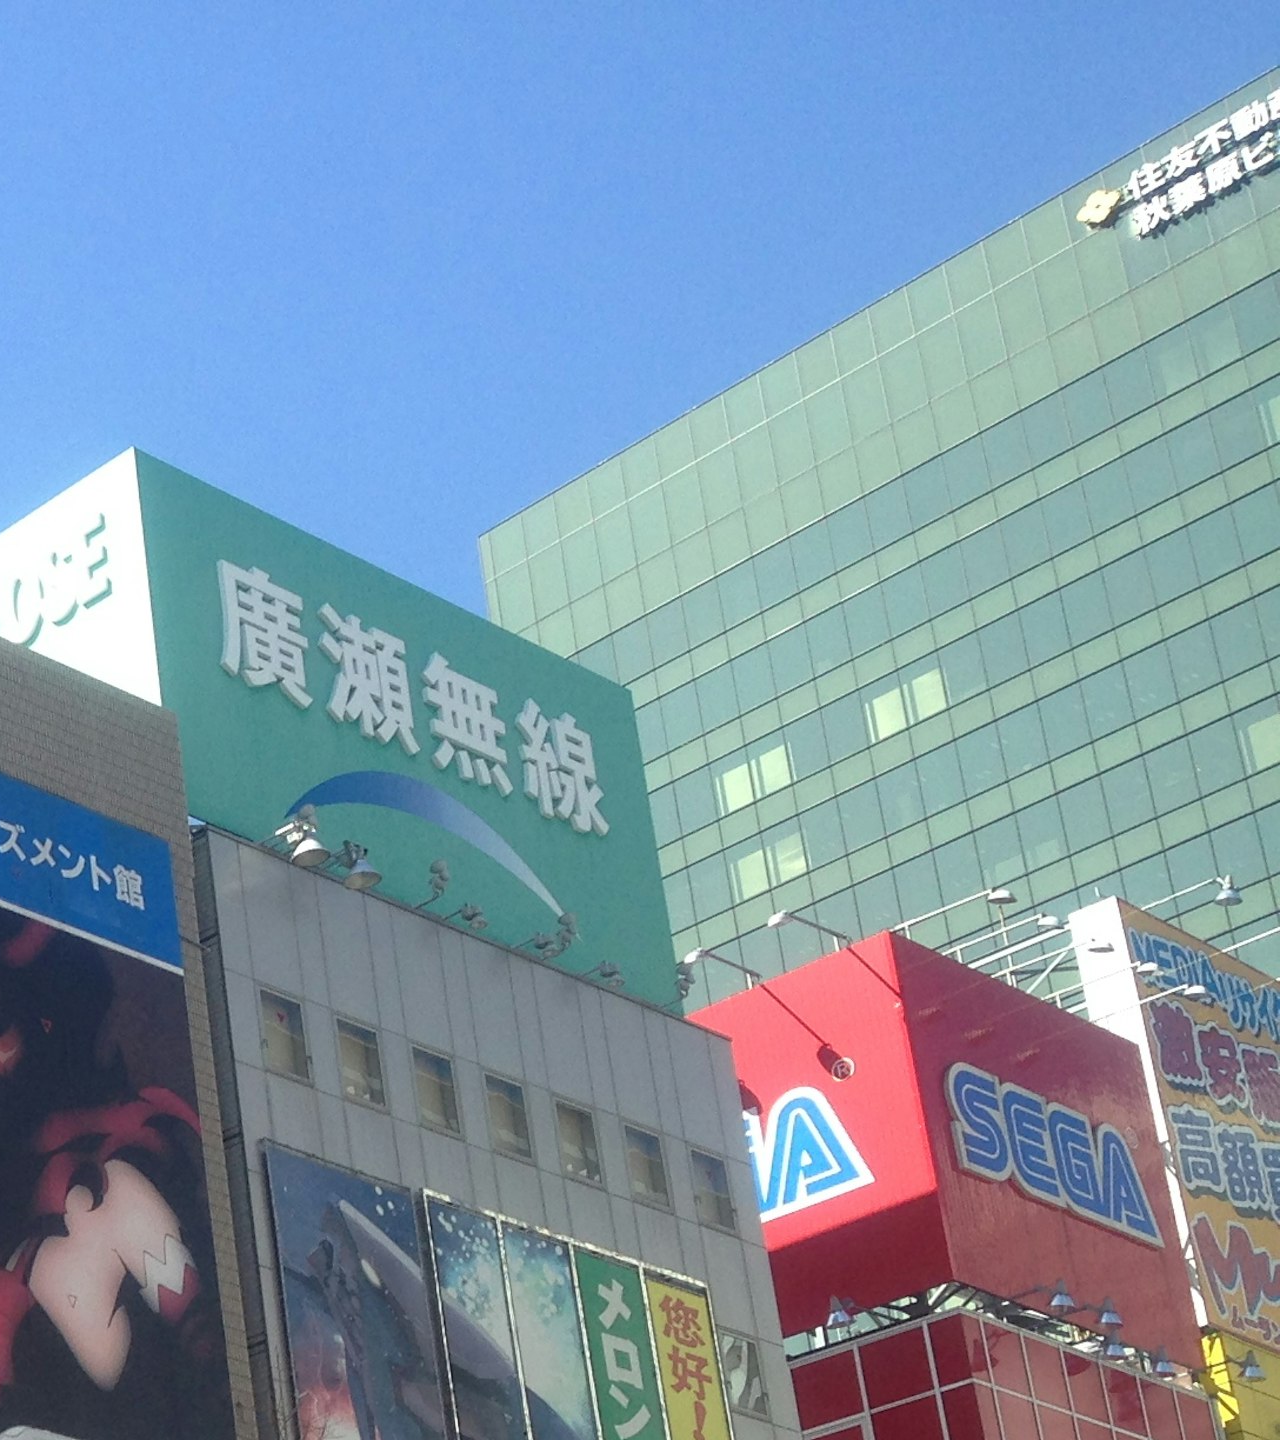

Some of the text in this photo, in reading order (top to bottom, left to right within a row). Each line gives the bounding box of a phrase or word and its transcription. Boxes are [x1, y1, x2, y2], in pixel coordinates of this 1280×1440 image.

[216, 557, 611, 838] 廣瀬無線
[944, 1061, 1166, 1250] SEGA
